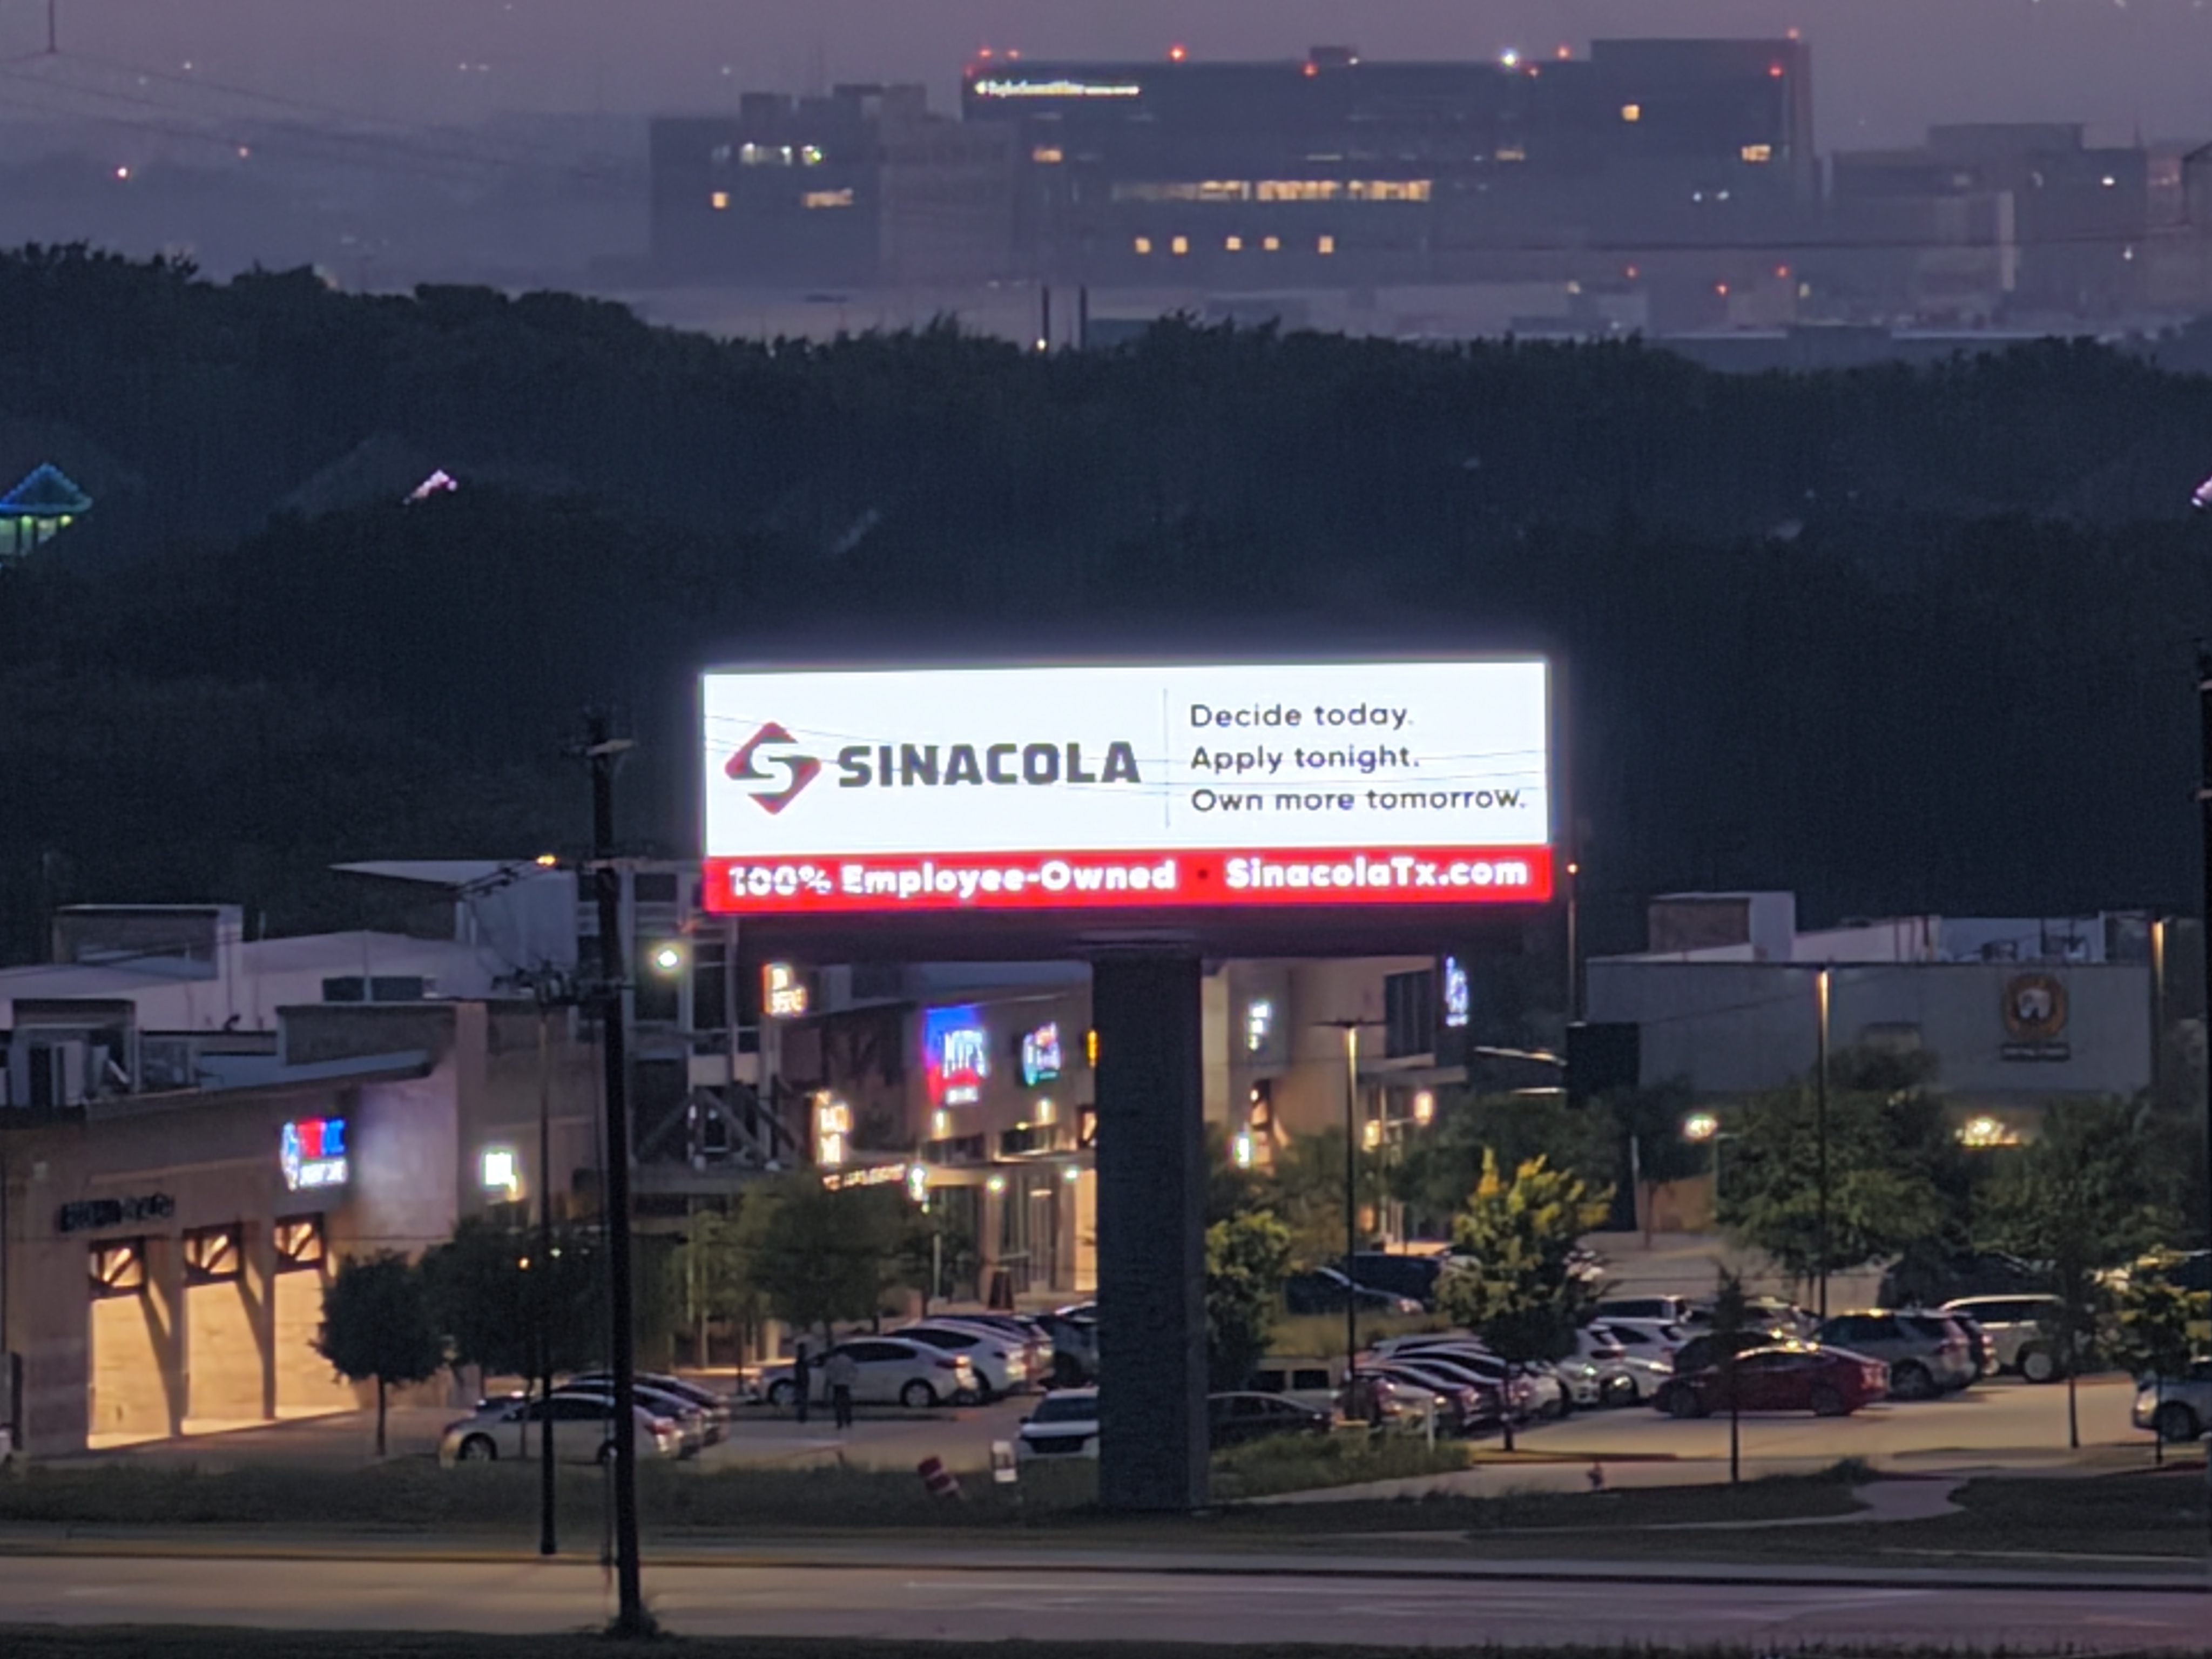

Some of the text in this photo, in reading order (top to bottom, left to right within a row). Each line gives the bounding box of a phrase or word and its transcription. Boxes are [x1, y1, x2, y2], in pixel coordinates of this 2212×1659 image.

[1190, 703, 1303, 727] Decide
[838, 741, 1141, 788] SINACOLA
[1190, 745, 1420, 774] Apply tonight.
[1191, 788, 1526, 811] Own more tomorrow.
[729, 856, 1529, 896] 100% Employee-Owned SinacolaTx.com
